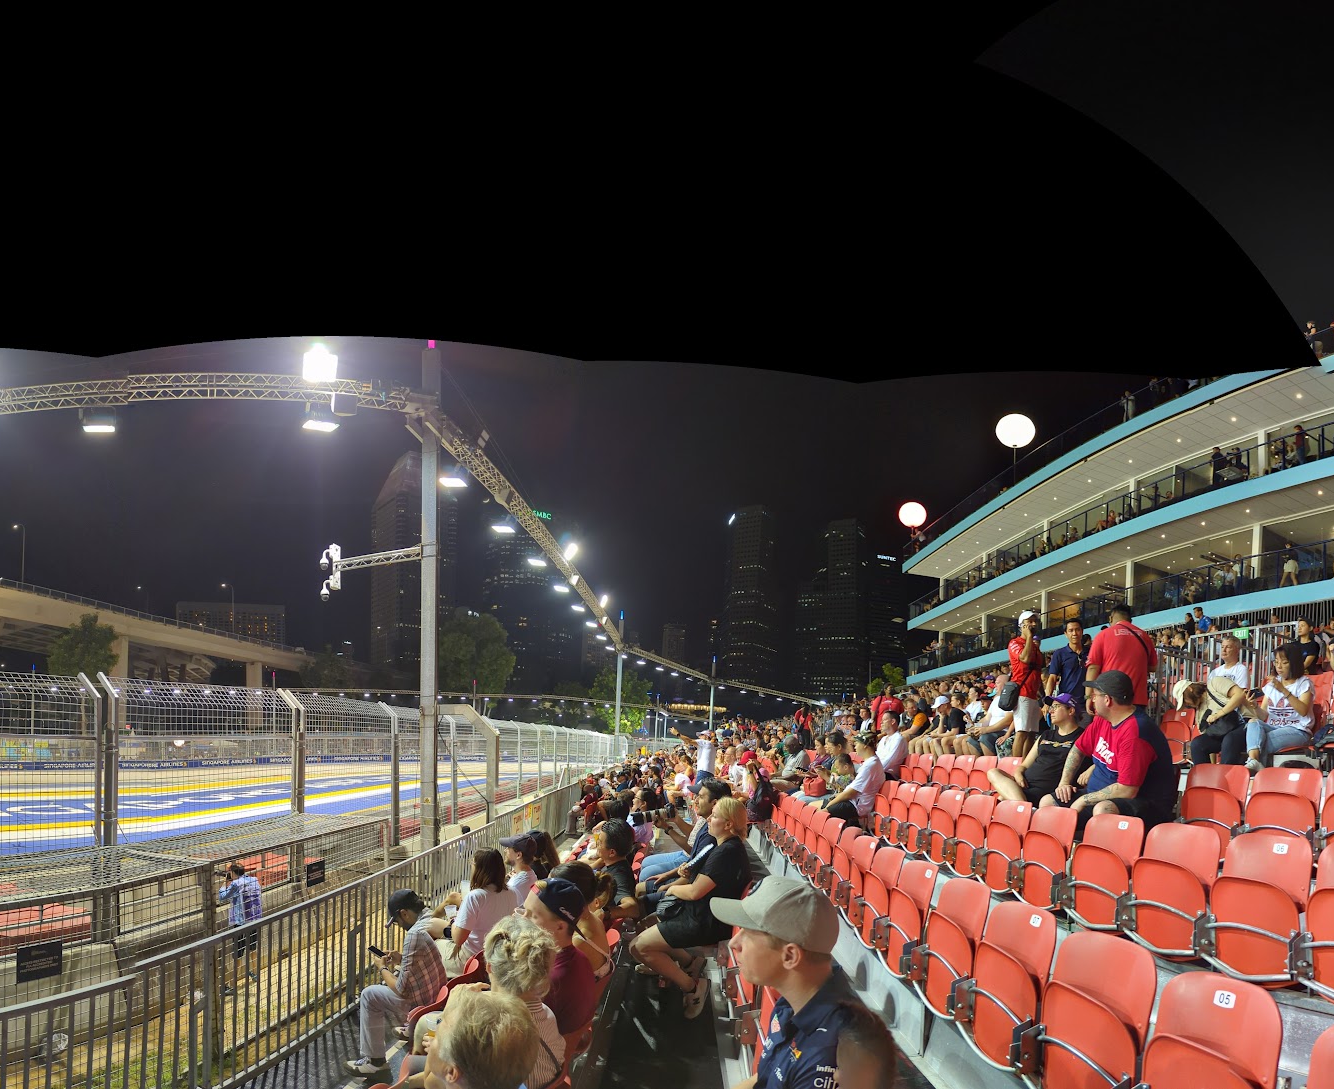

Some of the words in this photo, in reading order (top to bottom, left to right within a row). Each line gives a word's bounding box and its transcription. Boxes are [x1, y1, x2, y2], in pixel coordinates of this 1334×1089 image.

[877, 554, 897, 562] SUNTEC
[1235, 629, 1247, 638] EXIT
[1218, 992, 1231, 1005] 05
